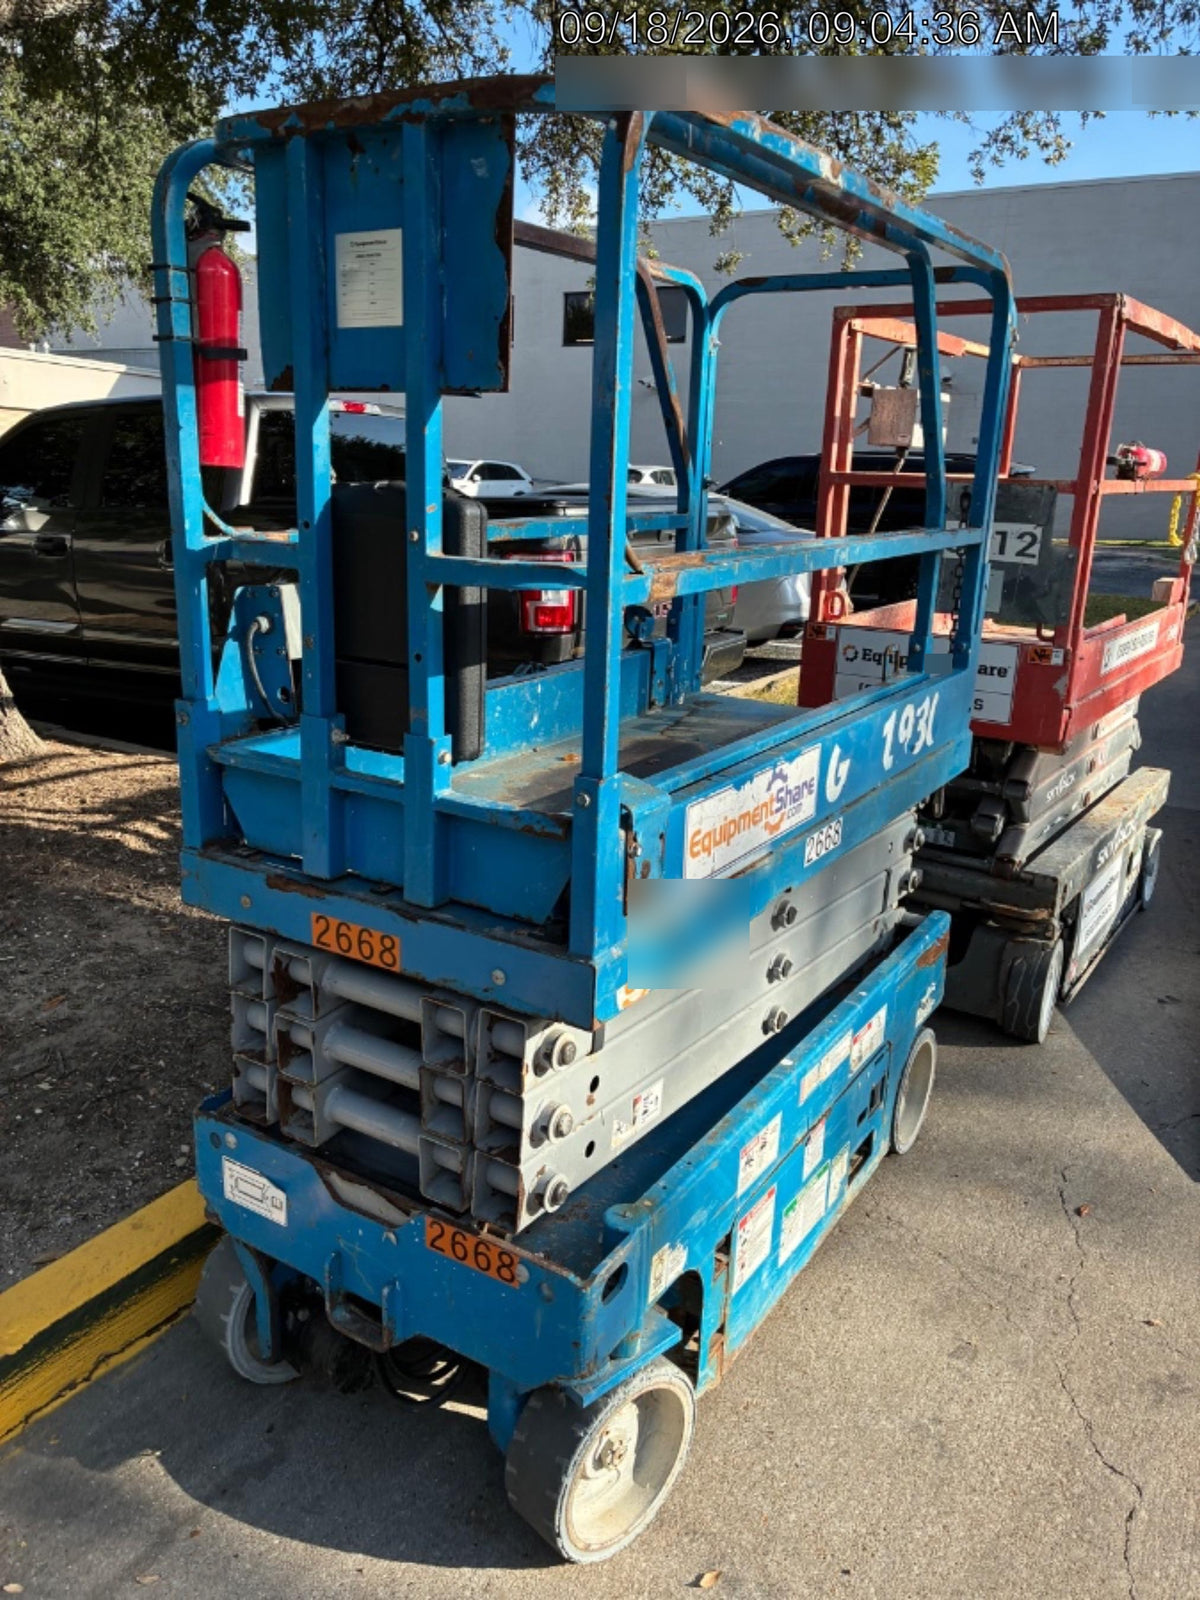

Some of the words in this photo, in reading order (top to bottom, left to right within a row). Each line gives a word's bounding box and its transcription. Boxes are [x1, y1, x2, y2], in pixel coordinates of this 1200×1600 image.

[806, 819, 842, 865] 2668
[315, 914, 398, 969] 2668
[429, 1220, 516, 1285] 2668
